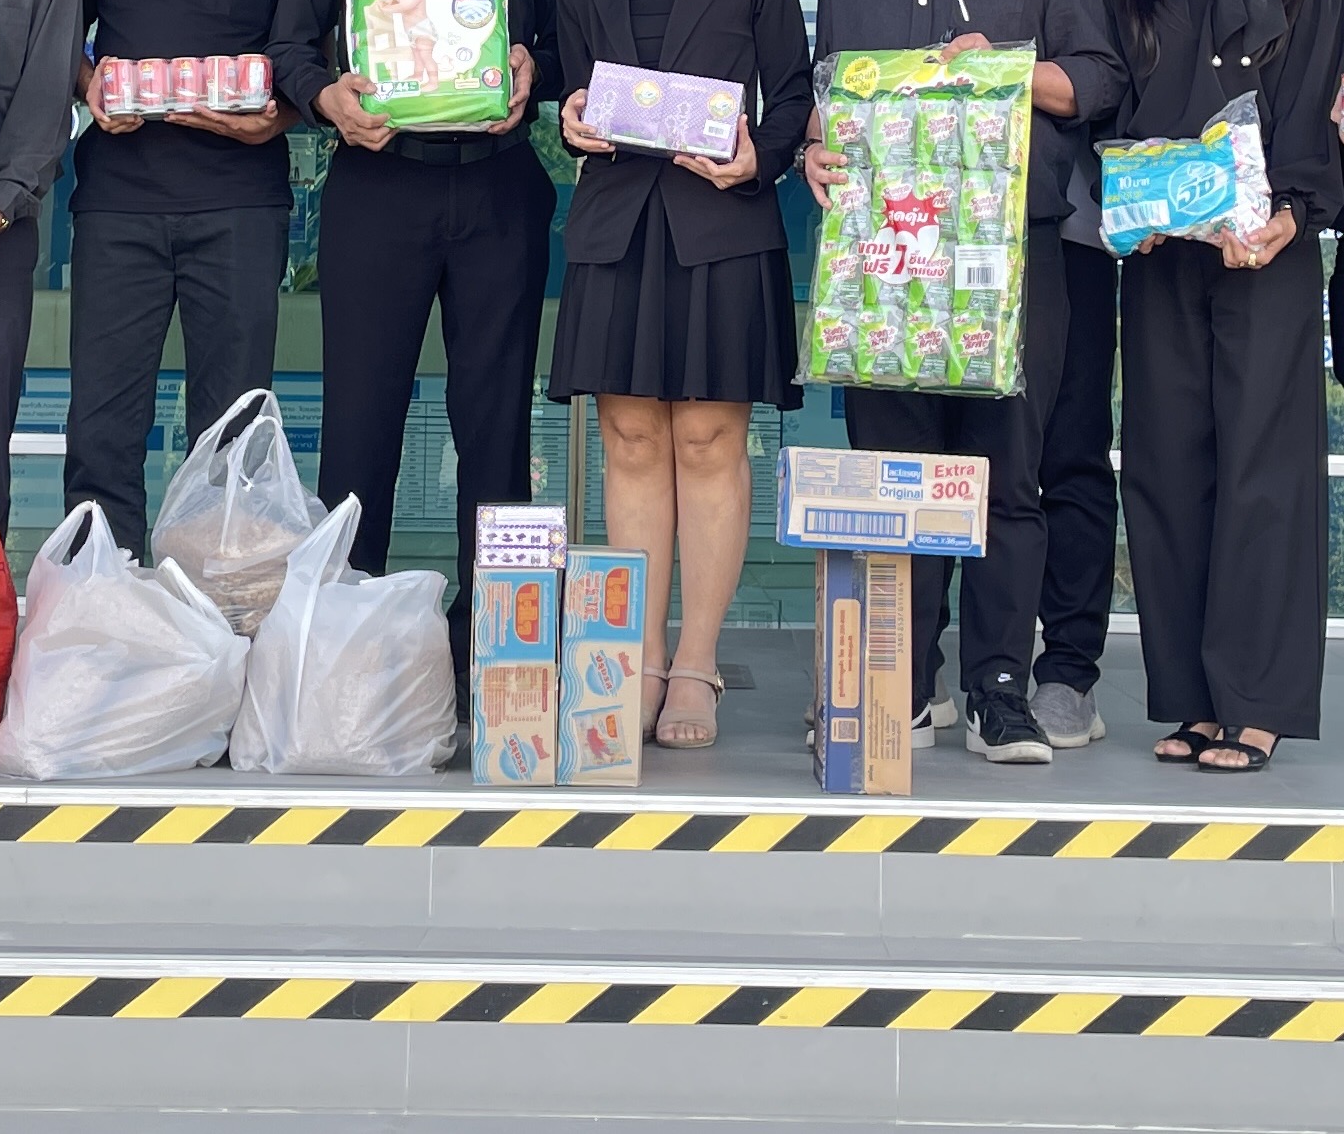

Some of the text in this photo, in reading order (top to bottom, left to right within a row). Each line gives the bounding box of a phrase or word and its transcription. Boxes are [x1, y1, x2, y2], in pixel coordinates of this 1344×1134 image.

[934, 464, 976, 477] Extra
[879, 481, 970, 500] Original 300
